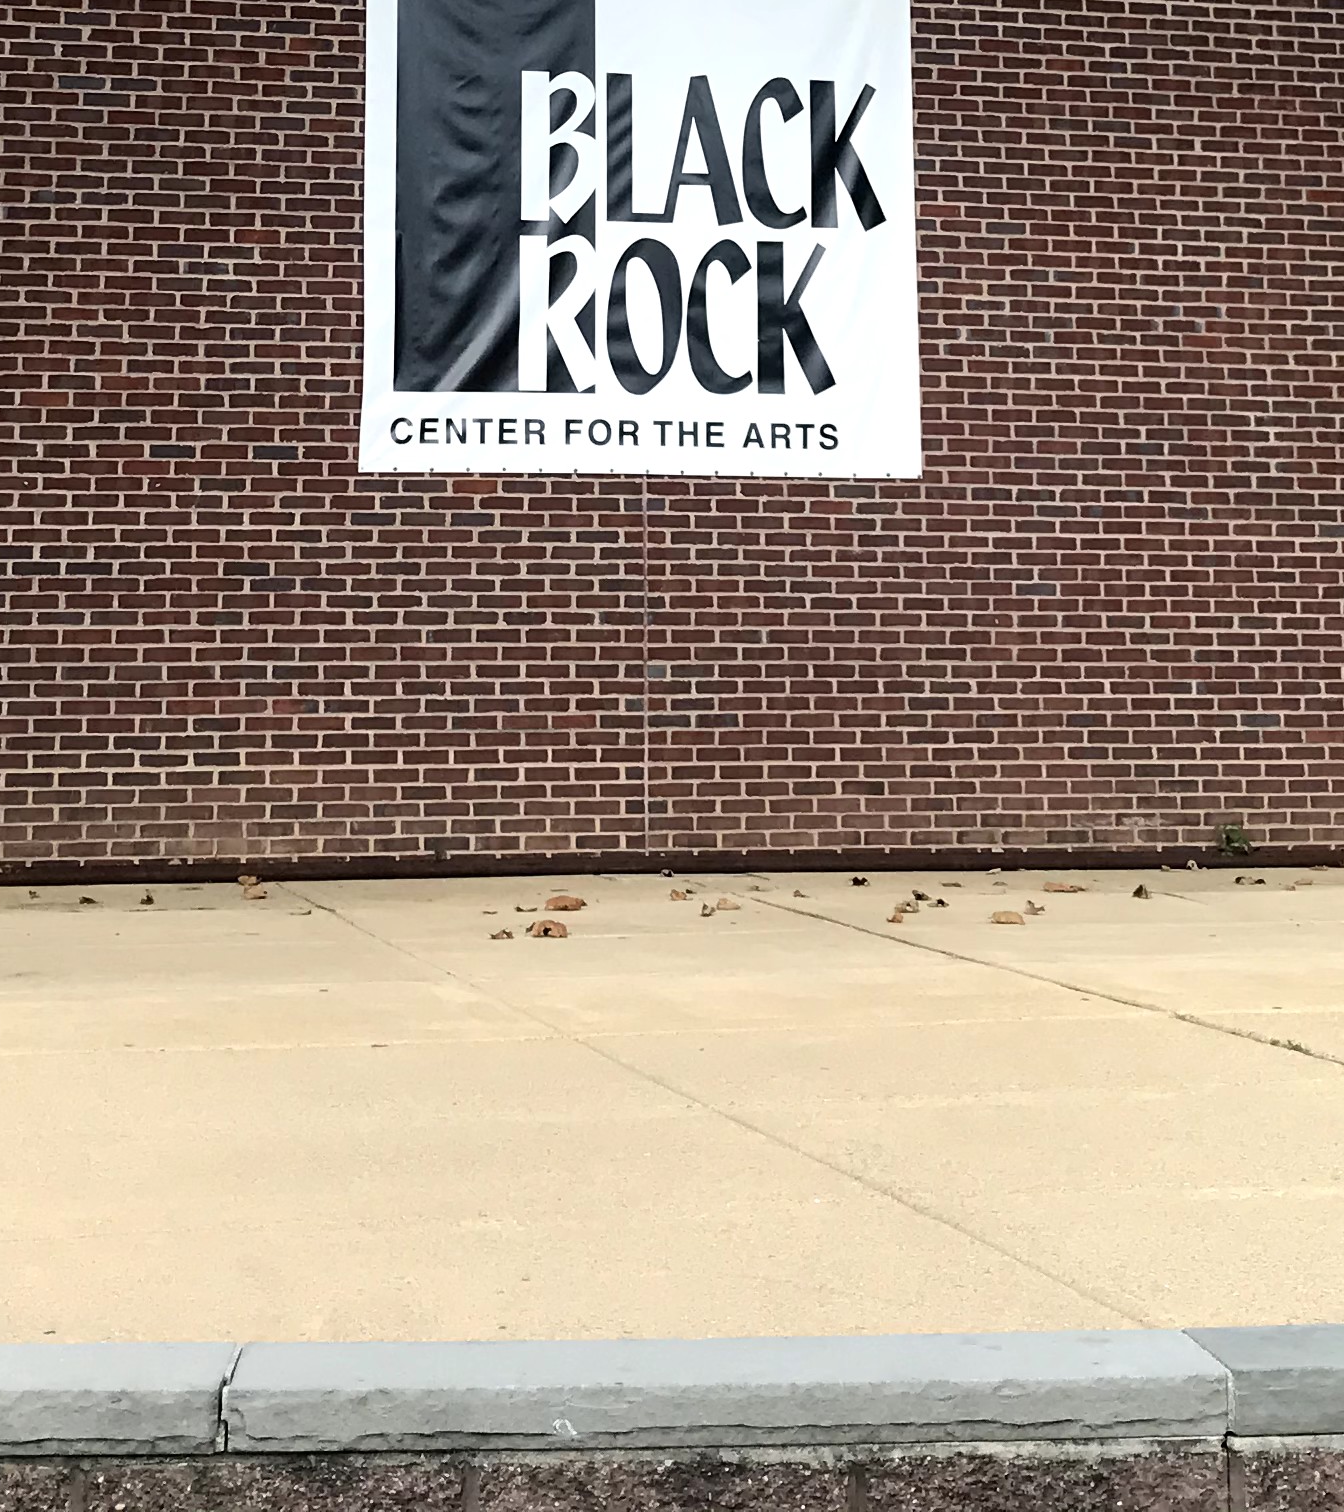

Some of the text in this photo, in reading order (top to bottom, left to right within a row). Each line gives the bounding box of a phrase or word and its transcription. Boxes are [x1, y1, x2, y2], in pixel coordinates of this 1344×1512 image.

[520, 69, 887, 232] BLACK
[518, 233, 837, 396] ROCK
[389, 416, 840, 451] CENTER FOR THE ARTS
